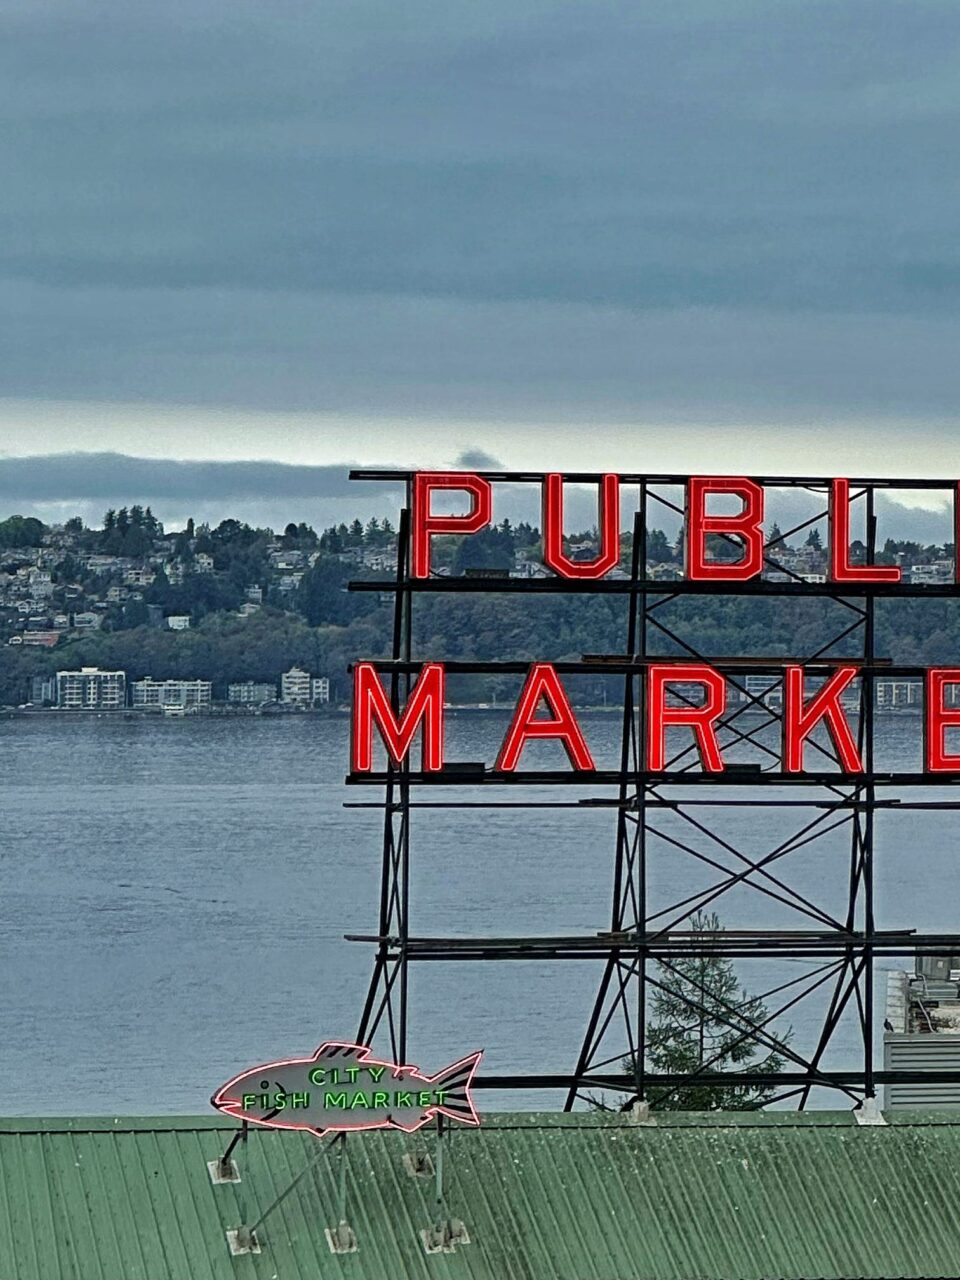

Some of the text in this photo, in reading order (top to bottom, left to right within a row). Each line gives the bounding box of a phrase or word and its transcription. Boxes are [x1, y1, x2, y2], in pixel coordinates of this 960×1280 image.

[308, 1067, 386, 1086] CITY
[242, 1089, 450, 1111] FISH MARKET
